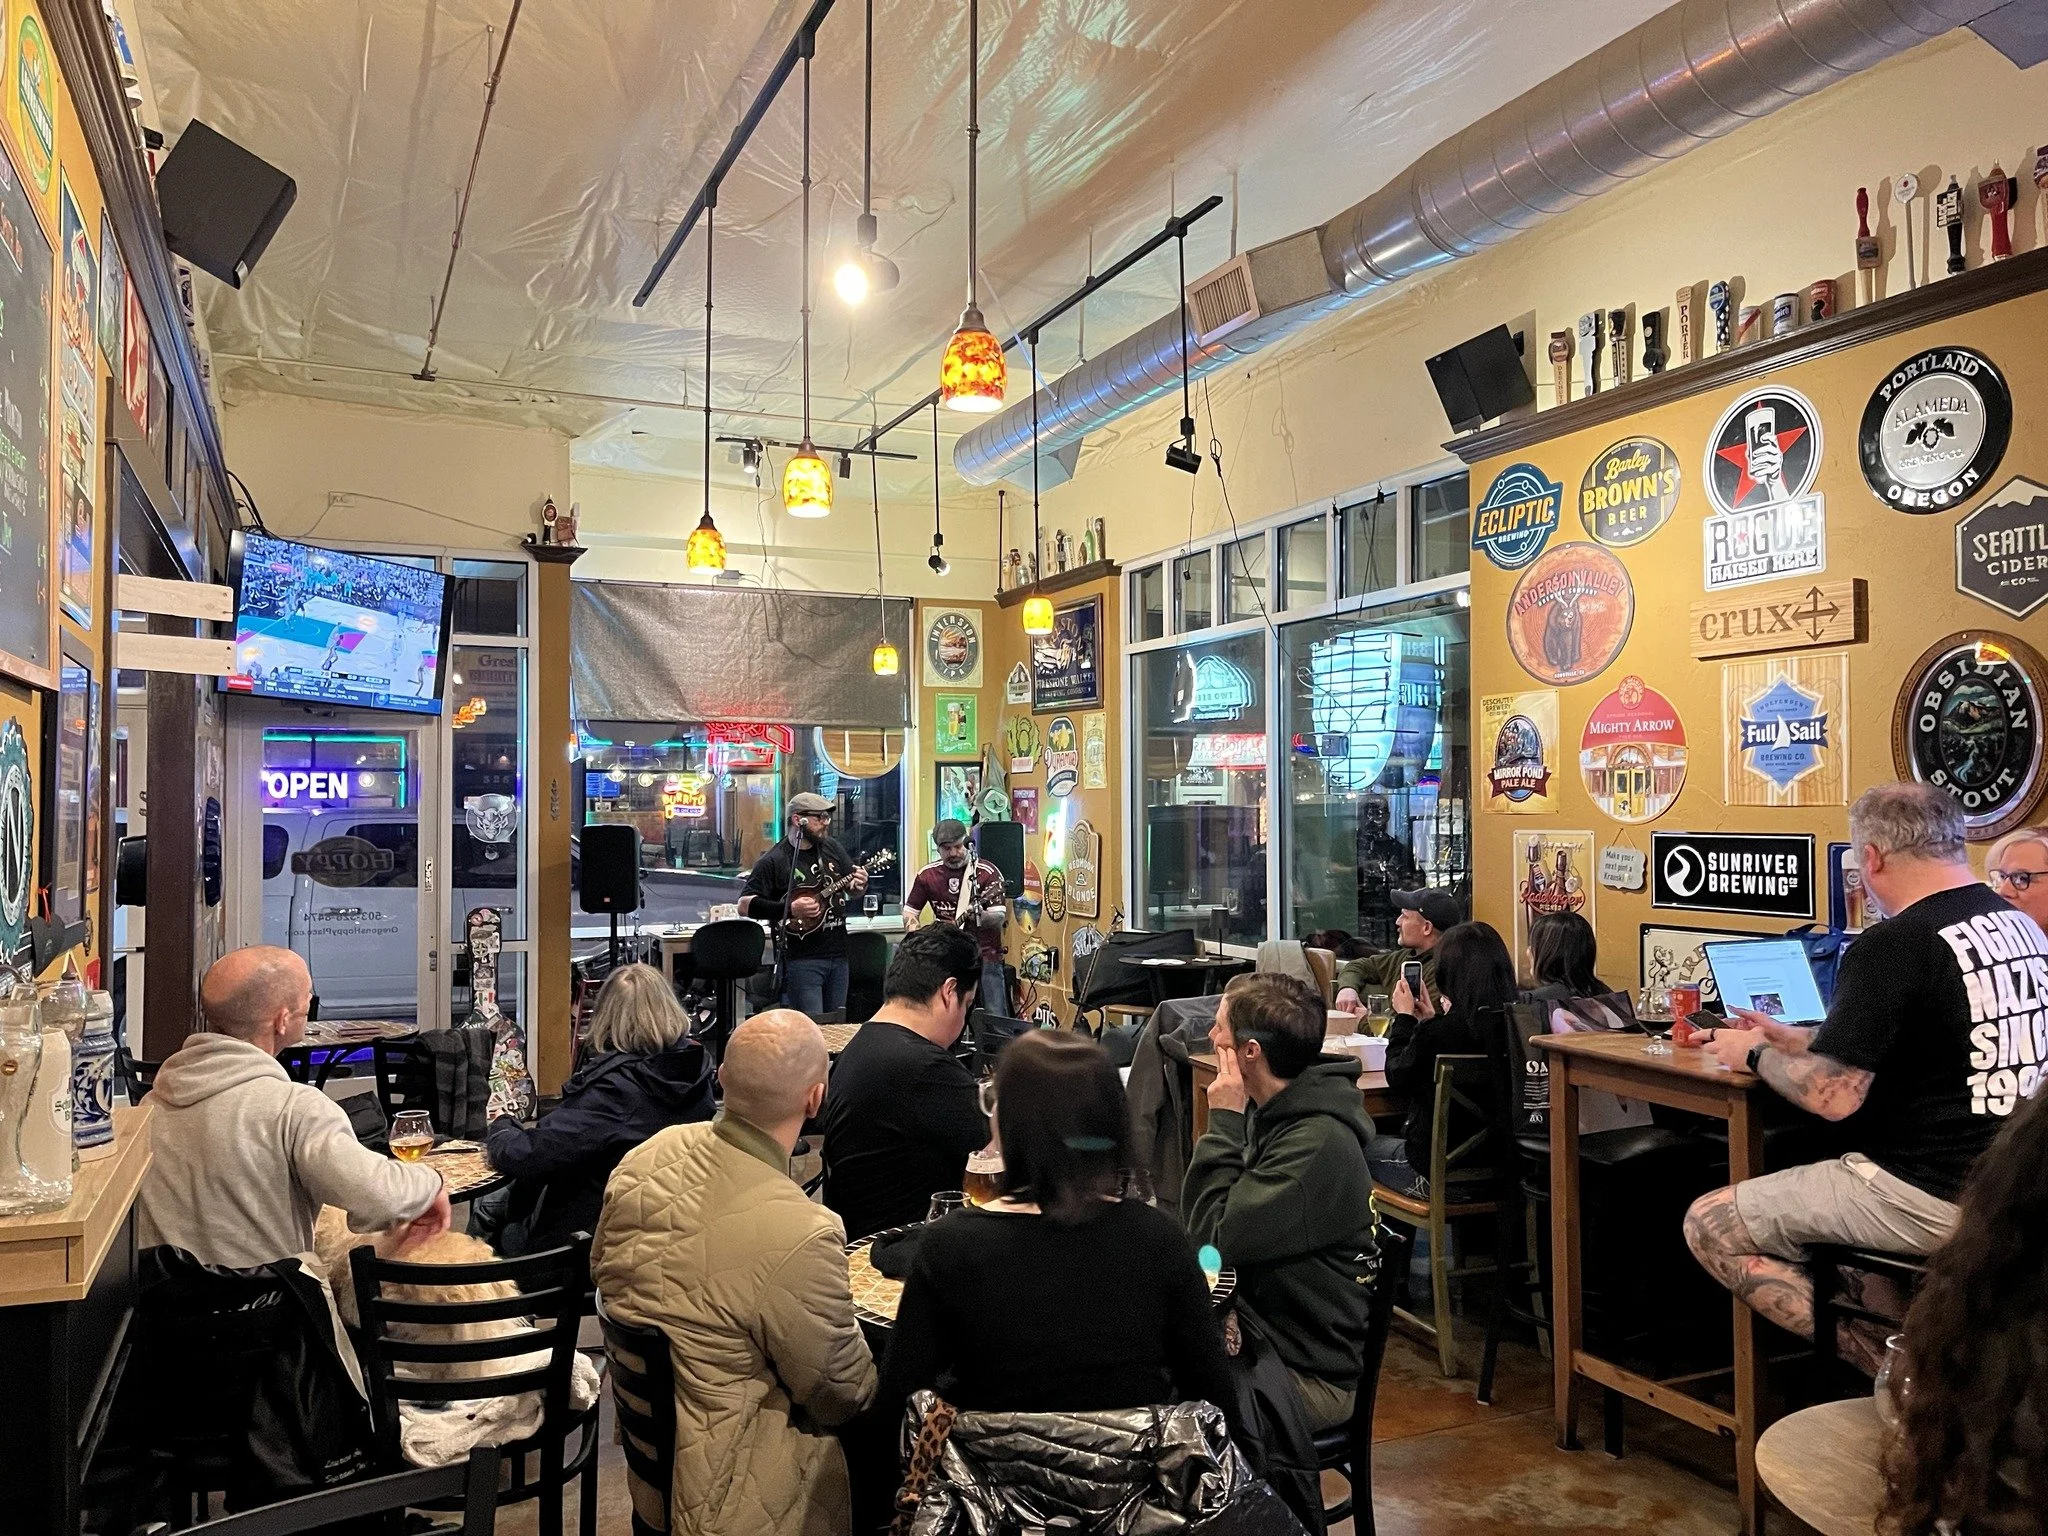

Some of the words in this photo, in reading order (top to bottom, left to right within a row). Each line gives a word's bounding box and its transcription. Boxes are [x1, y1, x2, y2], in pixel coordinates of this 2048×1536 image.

[1679, 304, 1690, 360] PORTER
[1879, 353, 1980, 402] PORTLAND
[1894, 395, 1969, 431] ALAMEDA
[1604, 449, 1651, 481] Barley
[1583, 468, 1675, 515] BROWN'S
[1887, 467, 1980, 507] OREGON
[1478, 496, 1555, 538] ECLIPTIC
[1607, 506, 1647, 526] BEER
[1498, 529, 1530, 544] BREWING
[1710, 499, 1818, 564] ROGUE
[1973, 523, 2048, 563] SEATTL
[1712, 557, 1769, 583] RAISED
[1772, 548, 1817, 573] HERE
[1986, 555, 2048, 576] CIDER
[1514, 571, 1576, 616] ANDERSON
[1579, 570, 1627, 597] VALLEY
[2010, 577, 2027, 586] CO
[930, 615, 977, 644] INVERSION
[1699, 602, 1793, 642] crux
[943, 667, 965, 678] IPA
[1482, 696, 1514, 706] DESCHUTES
[1485, 704, 1511, 712] BREWERY
[1756, 698, 1809, 713] INDEPENDENT
[1919, 659, 2028, 733] OBSIDIAN
[1747, 723, 1777, 743] Full
[1789, 721, 1822, 741] Sail
[1760, 753, 1792, 761] BREWING
[267, 772, 348, 799] OPEN
[1493, 766, 1521, 780] MIRROR
[1522, 765, 1544, 779] POND
[1501, 779, 1520, 788] PALE
[1520, 778, 1536, 787] ALE
[1930, 767, 2017, 808] STOUT
[1068, 860, 1095, 874] REDHOOK
[1707, 851, 1798, 875] SUNRIVER
[1049, 889, 1062, 900] HUB
[1067, 884, 1096, 902] BLONDE
[1708, 873, 1789, 896] BREWING
[1962, 956, 2048, 1023] NAZIS
[1969, 1009, 2048, 1070] SINC
